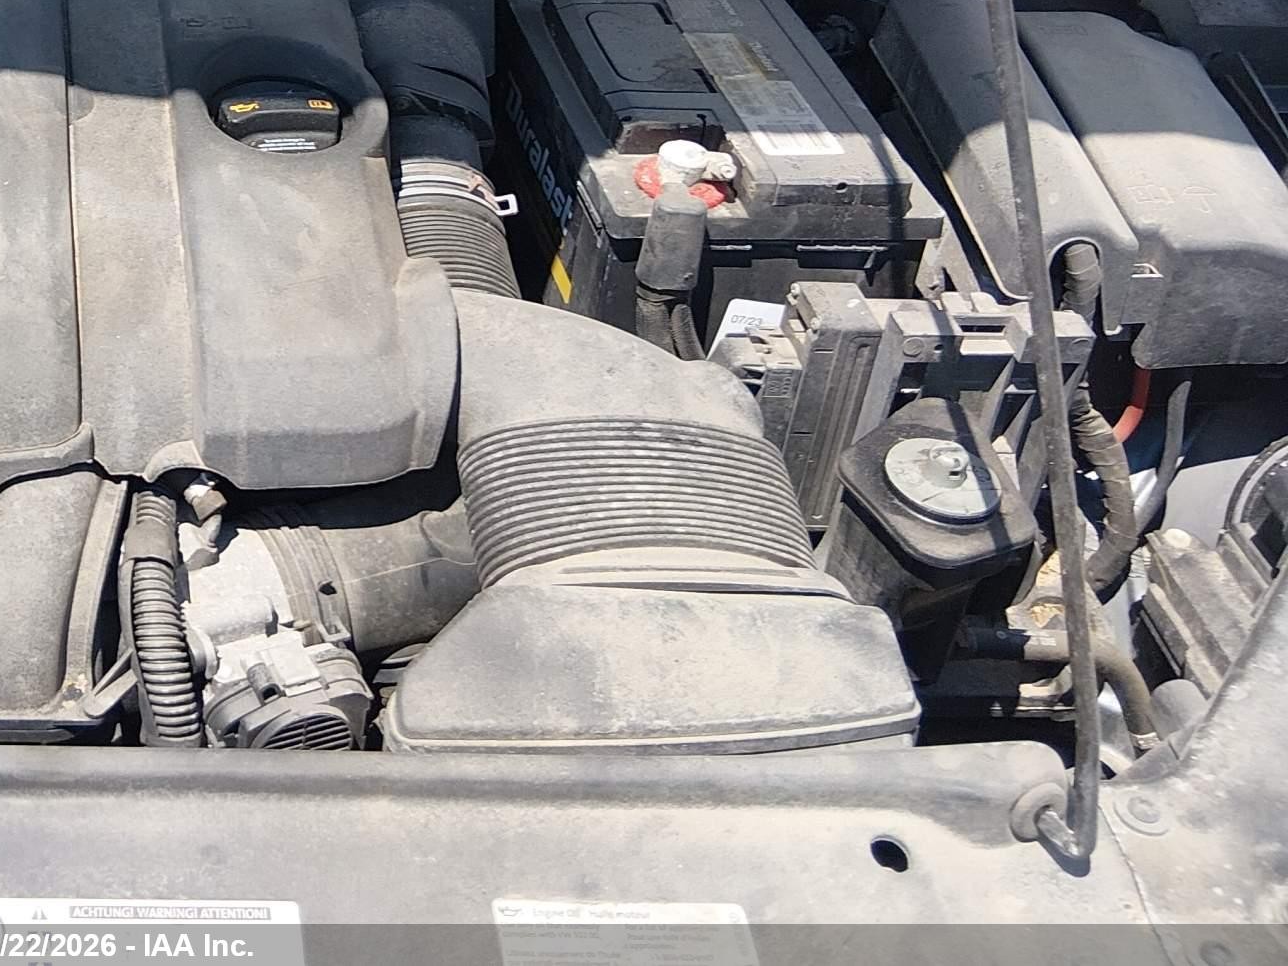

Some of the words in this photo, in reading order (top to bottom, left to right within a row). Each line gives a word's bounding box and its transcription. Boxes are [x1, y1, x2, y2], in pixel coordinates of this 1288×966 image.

[505, 71, 573, 236] Duralast
[730, 313, 763, 327] 07/23
[72, 906, 134, 918] ACHTUNG!
[137, 906, 199, 919] WARNING!
[200, 907, 268, 919] ATTENTION!
